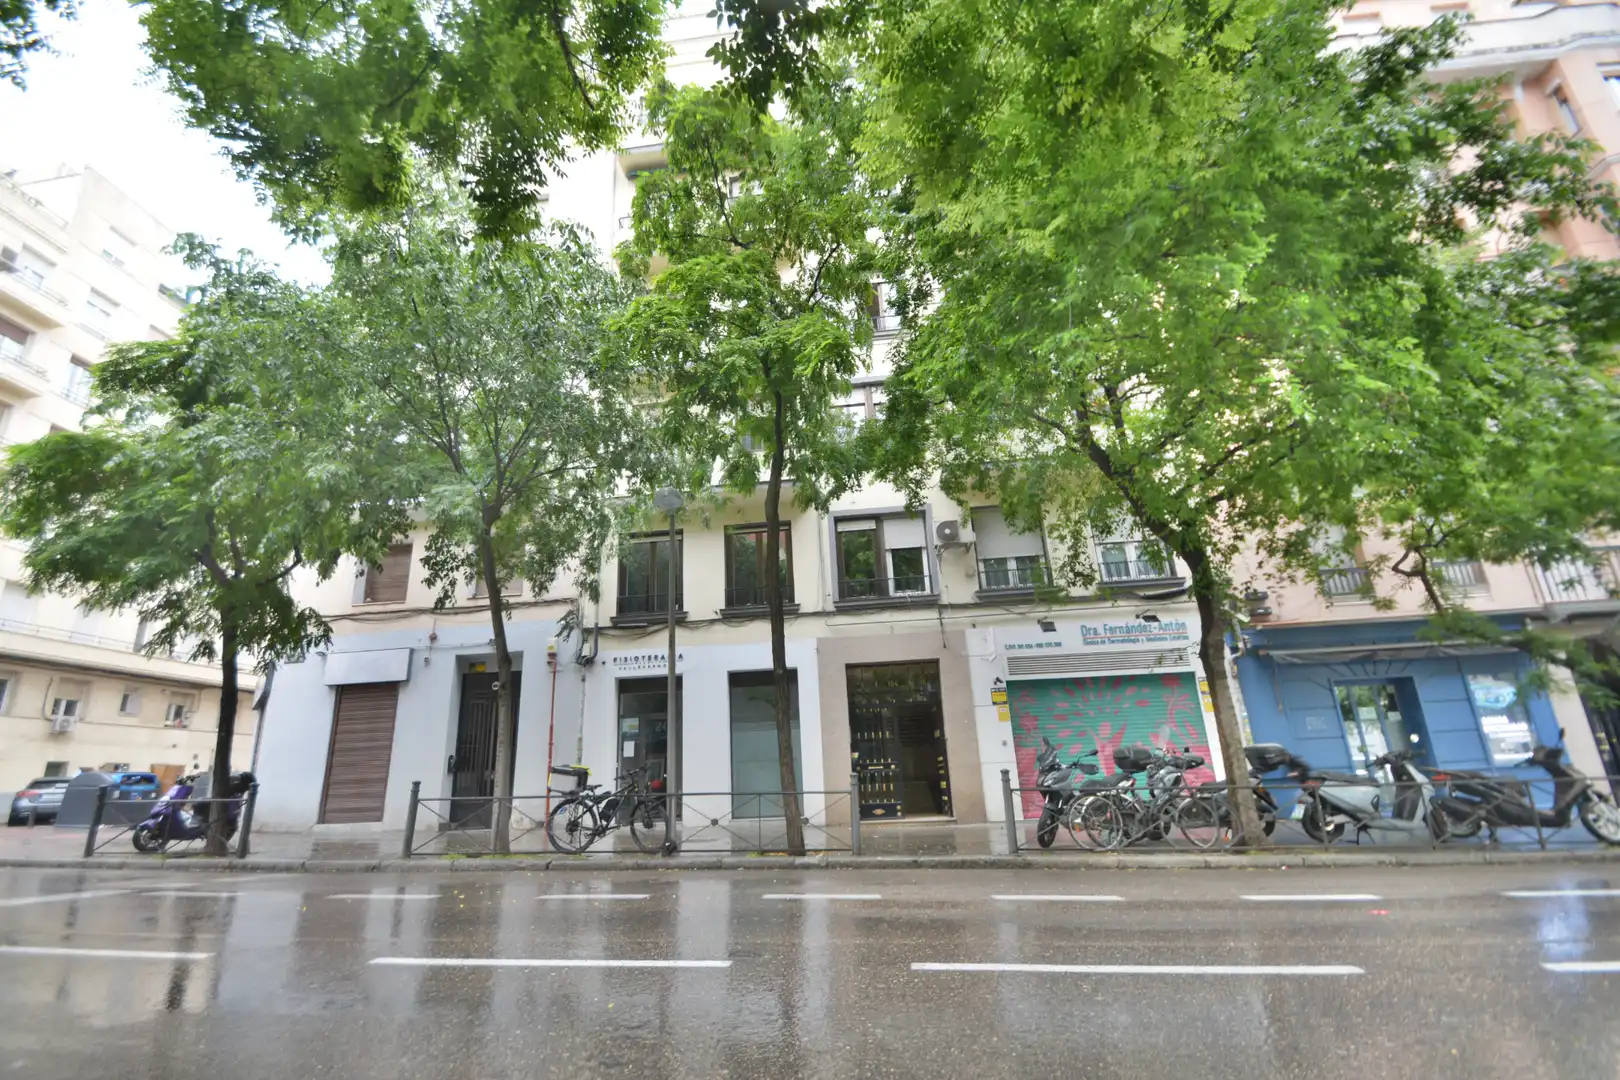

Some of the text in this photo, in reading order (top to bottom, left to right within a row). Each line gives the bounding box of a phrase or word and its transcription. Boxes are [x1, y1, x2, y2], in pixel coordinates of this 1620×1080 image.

[1081, 619, 1187, 637] Dra. Fernández-Antón
[613, 653, 683, 663] FISIOTERAA
